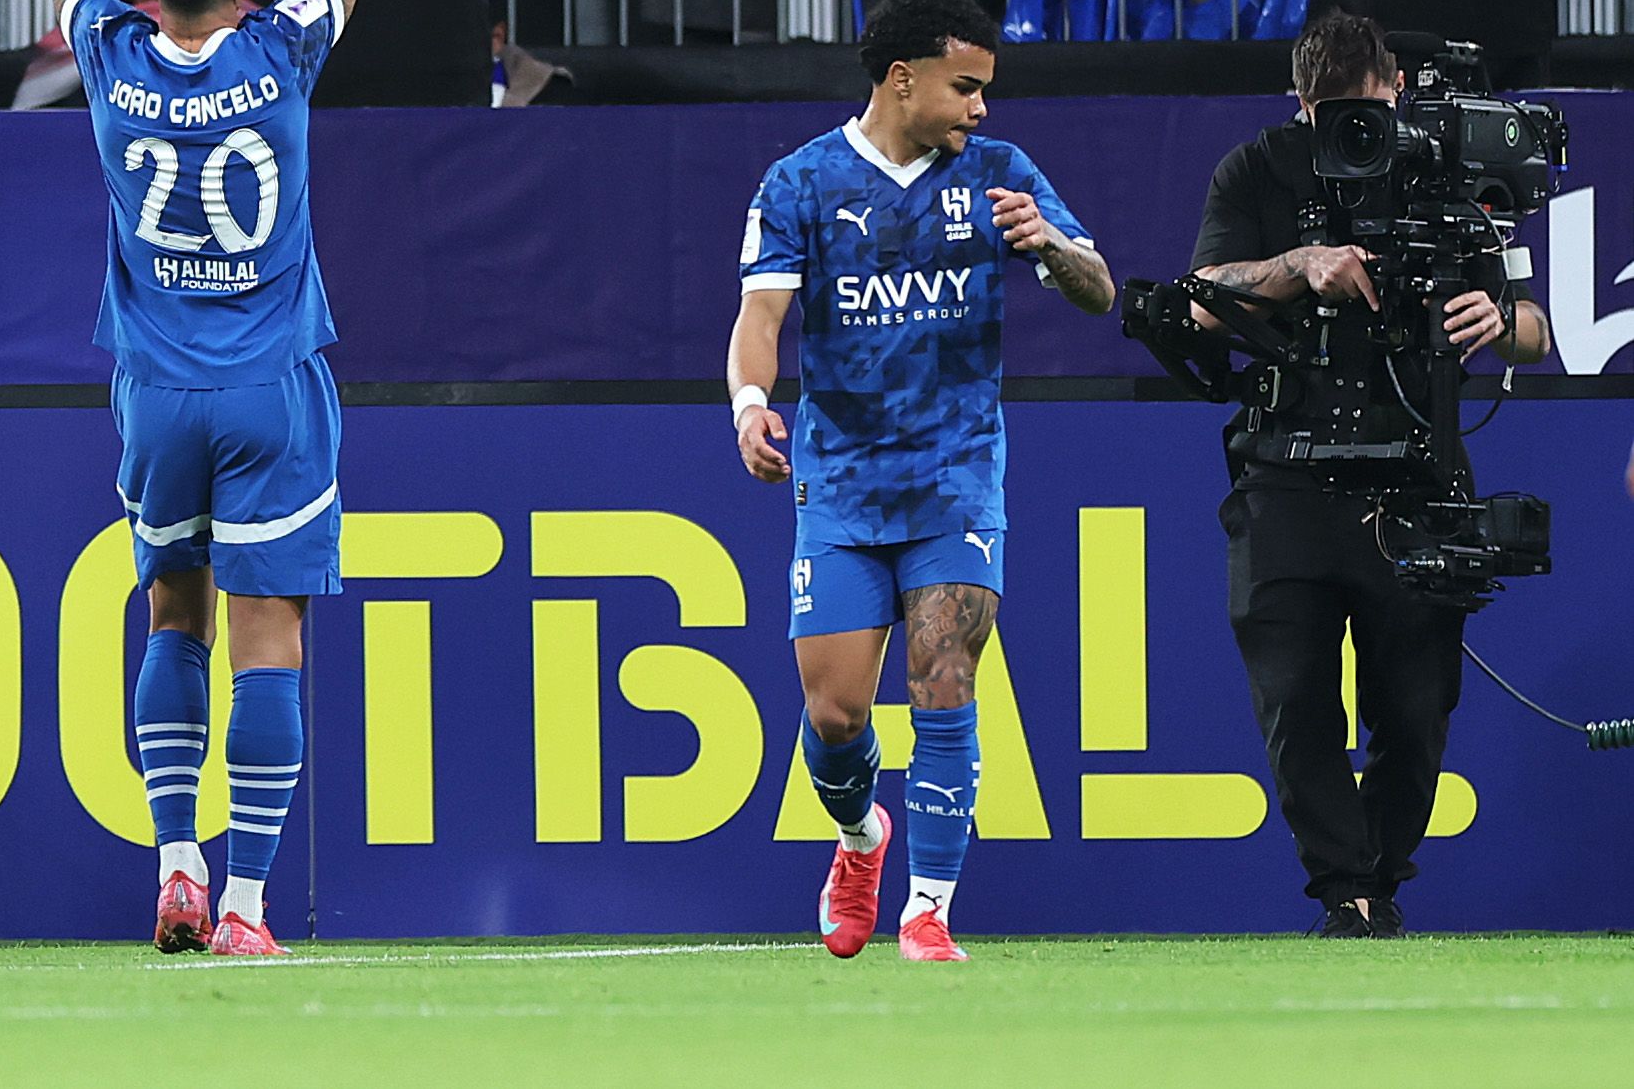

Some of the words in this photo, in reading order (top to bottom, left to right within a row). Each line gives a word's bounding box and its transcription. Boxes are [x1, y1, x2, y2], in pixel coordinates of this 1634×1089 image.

[108, 78, 163, 120] JOÃO
[169, 74, 280, 128] CANCELO
[124, 127, 280, 255] 20
[181, 260, 259, 282] ALHILAL
[836, 267, 971, 310] SAVVY
[842, 312, 905, 326] GAMES
[926, 804, 966, 817] HILAL
